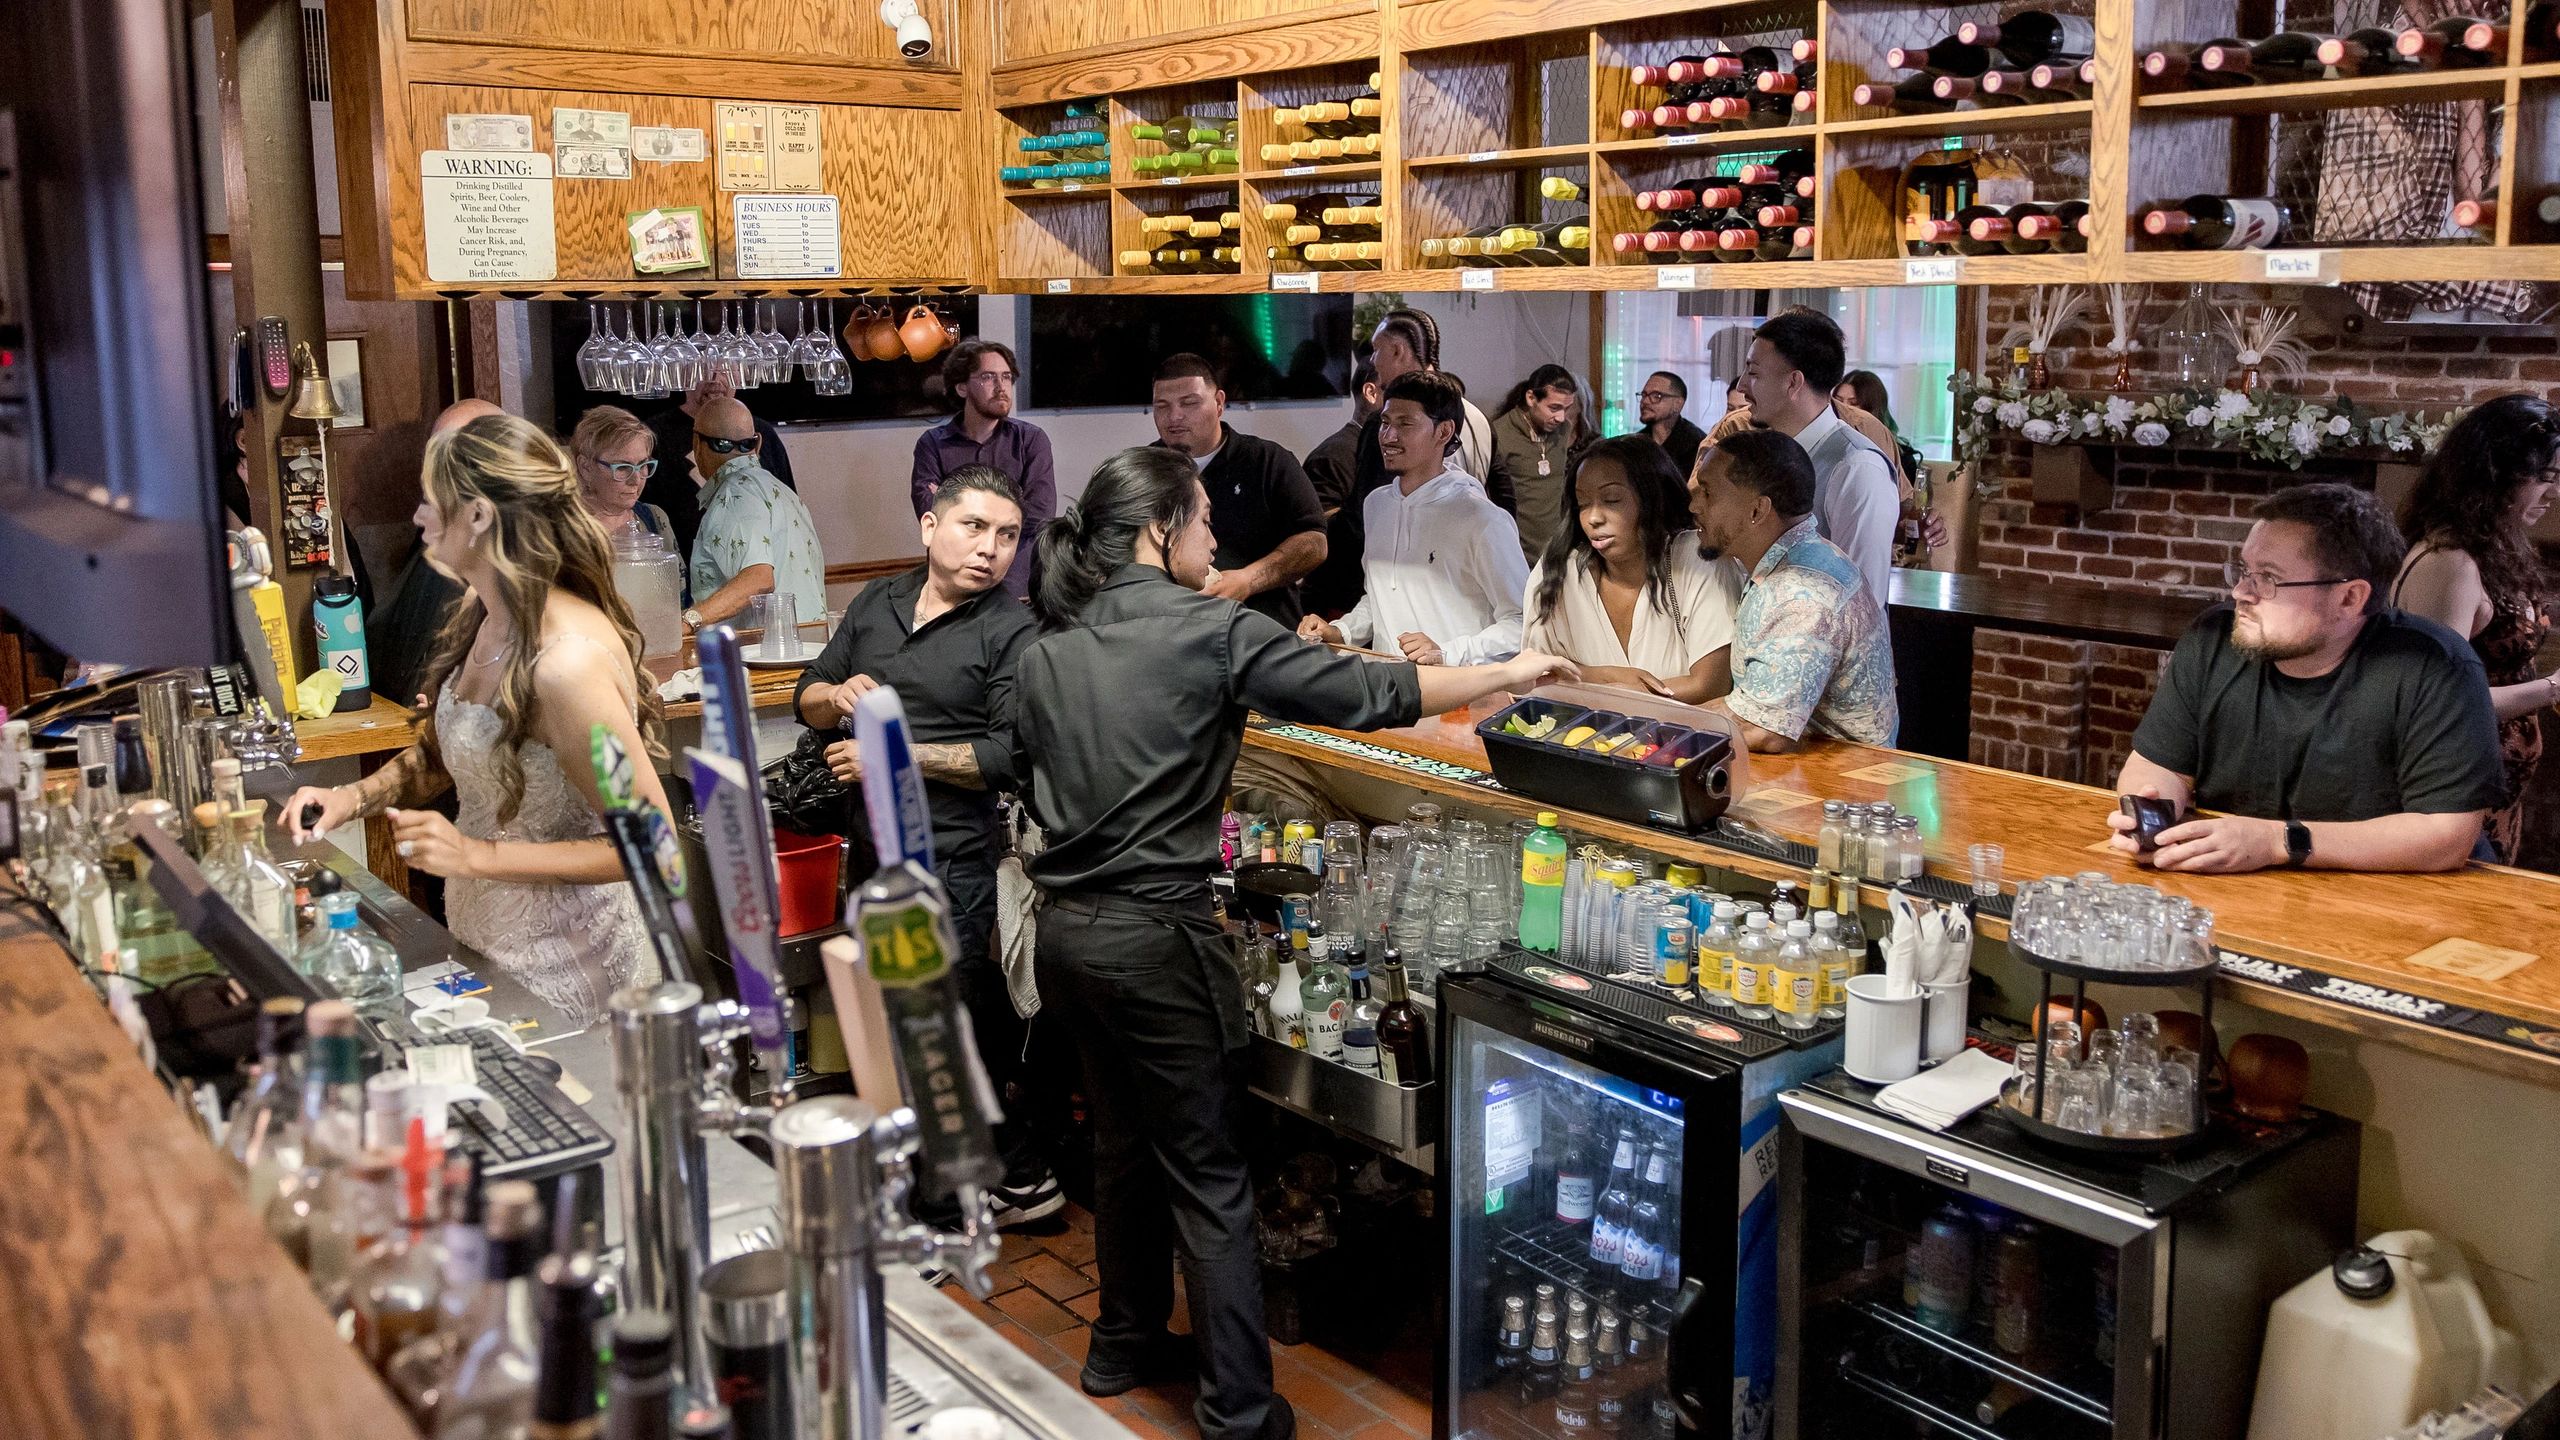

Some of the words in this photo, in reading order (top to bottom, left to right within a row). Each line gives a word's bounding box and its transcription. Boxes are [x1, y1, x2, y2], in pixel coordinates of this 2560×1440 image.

[444, 158, 532, 176] WARNING:
[456, 181, 490, 191] Drinking
[492, 182, 523, 191] Distilled
[450, 192, 476, 202] Spirits,
[478, 193, 497, 202] Beer,
[499, 193, 530, 202] Coolers,
[460, 203, 480, 212] Wine
[483, 203, 497, 212] and
[498, 204, 521, 212] Other
[743, 202, 793, 213] BUSINESS
[795, 202, 831, 213] HOURS
[453, 215, 489, 223] Alcoholic
[491, 215, 529, 224] Beverages
[467, 226, 483, 234] May
[486, 226, 516, 234] Increase
[459, 237, 486, 245] Cancer
[488, 237, 508, 246] Risk,
[509, 237, 526, 246] and,
[458, 248, 485, 256] During
[487, 248, 528, 257] Pregnancy,
[473, 259, 489, 267] Can
[491, 259, 514, 267] Cause
[468, 269, 488, 278] Birth
[490, 269, 520, 278] Defects.
[214, 685, 239, 715] ROCK
[1531, 857, 1564, 879] Squirt
[2328, 977, 2445, 1014] TRULY
[1535, 1022, 1588, 1050] HUSSMANN
[1599, 1400, 1622, 1413] odelo
[1556, 1407, 1587, 1427] Modelo
